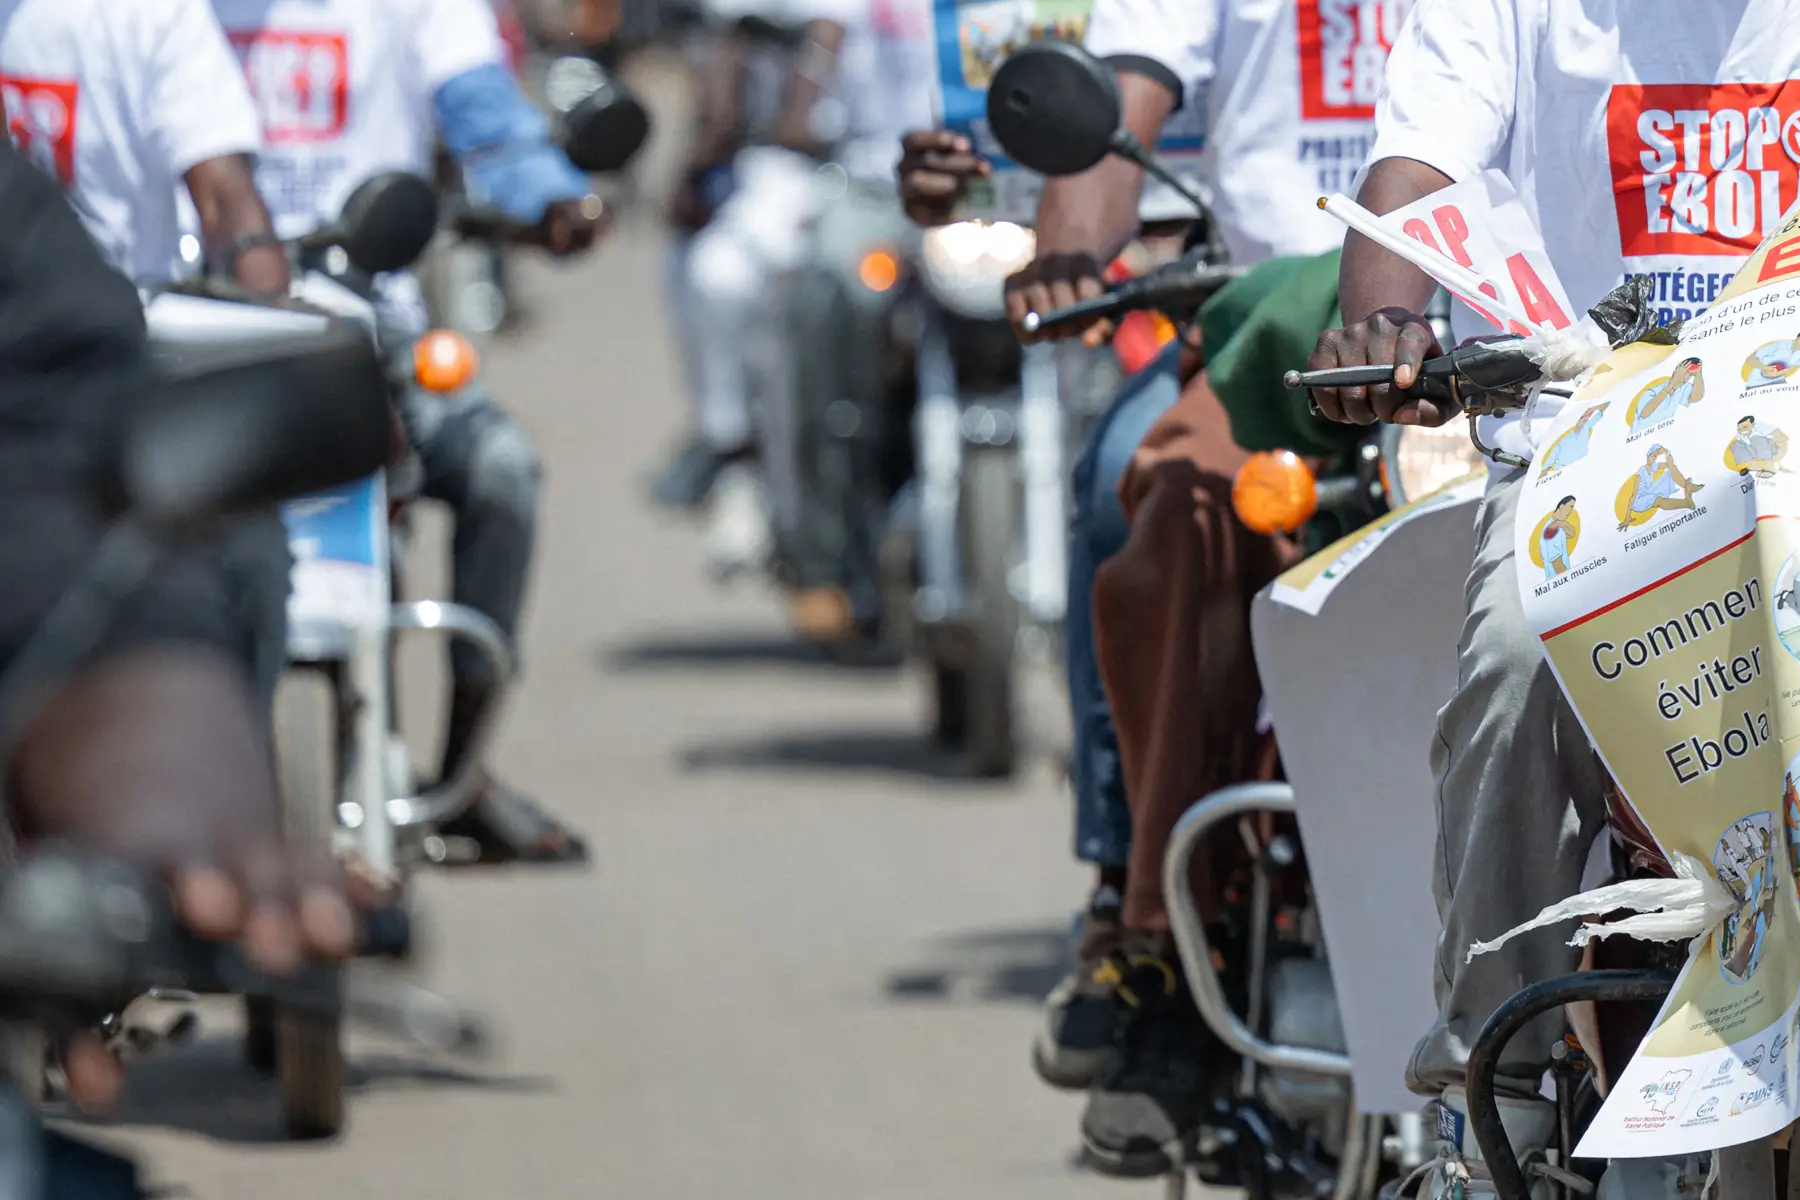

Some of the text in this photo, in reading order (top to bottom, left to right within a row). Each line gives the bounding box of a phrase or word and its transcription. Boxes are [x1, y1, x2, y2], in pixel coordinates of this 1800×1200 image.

[1637, 107, 1781, 174] STOP
[1688, 320, 1735, 344] santé
[1740, 314, 1754, 328] le
[1760, 305, 1796, 324] plus
[1717, 300, 1753, 319] d'un
[1758, 292, 1780, 306] de
[1739, 389, 1757, 400] Mal
[1759, 387, 1773, 395] au
[1625, 419, 1675, 445] Mal de tête
[1624, 506, 1708, 552] Fatigue importante
[1534, 555, 1608, 598] Mal aux muscles
[1591, 577, 1762, 680] Commen
[1658, 645, 1761, 720] éviter
[1665, 711, 1770, 785] Ebola
